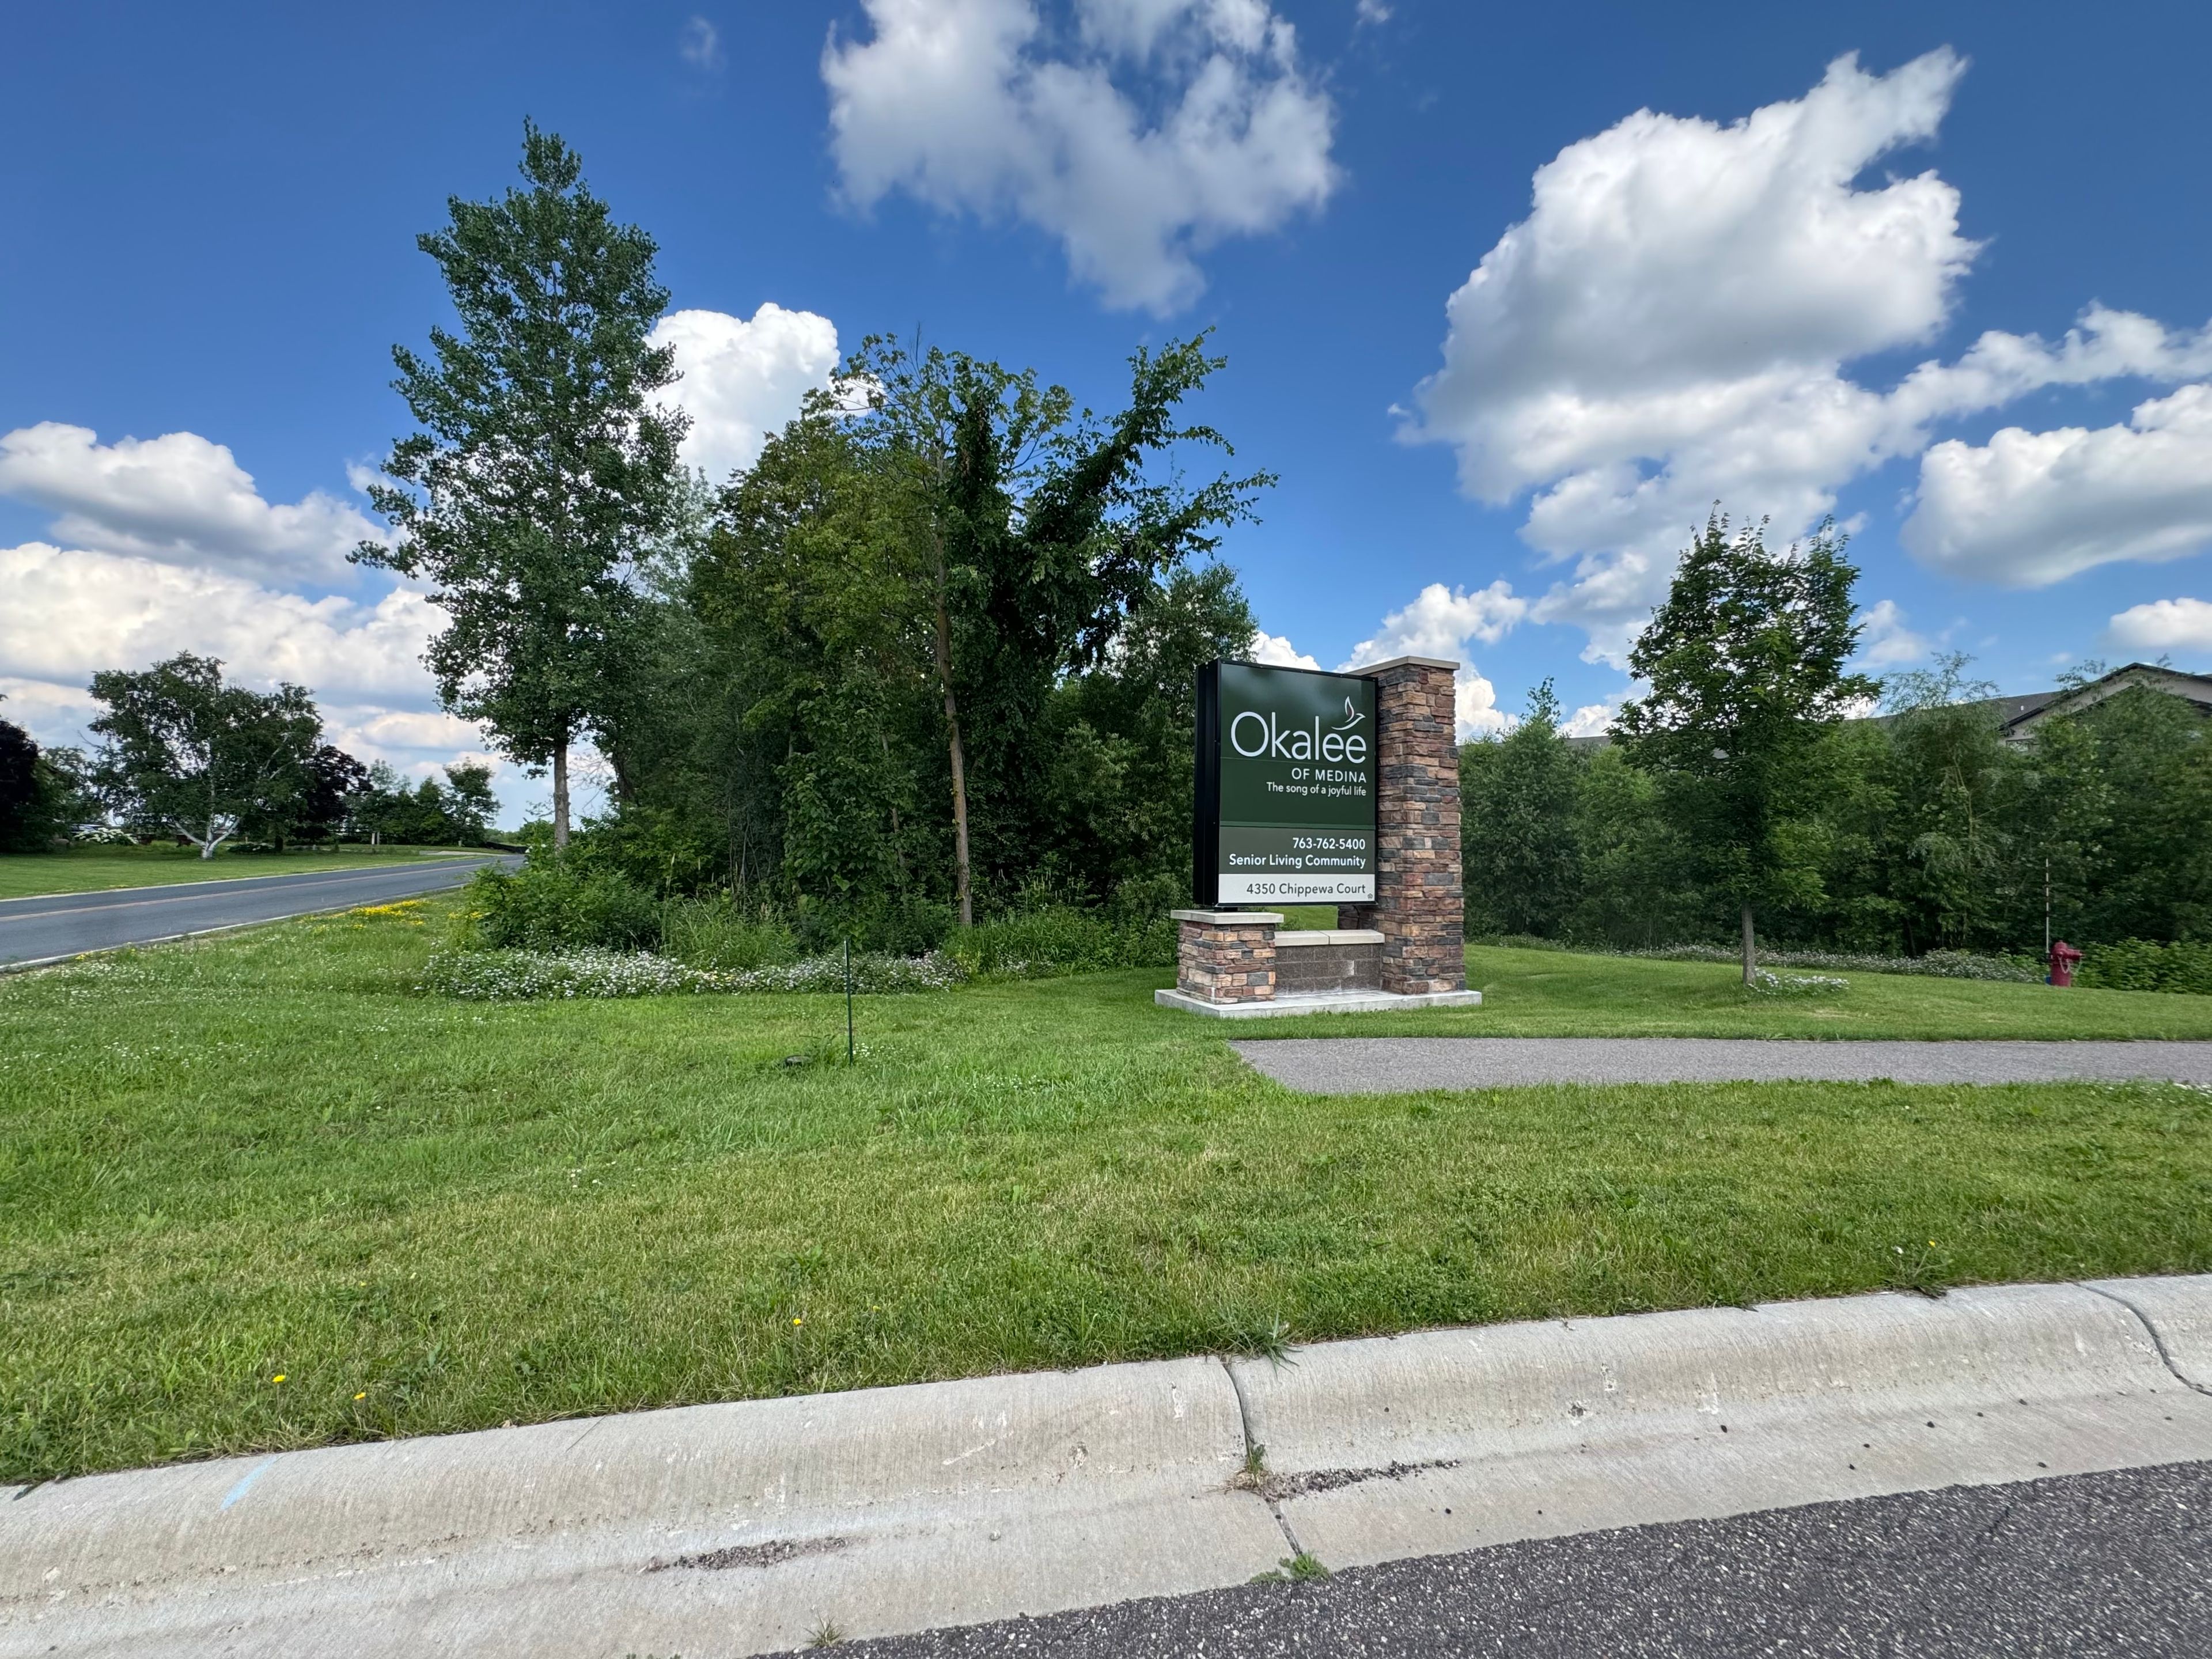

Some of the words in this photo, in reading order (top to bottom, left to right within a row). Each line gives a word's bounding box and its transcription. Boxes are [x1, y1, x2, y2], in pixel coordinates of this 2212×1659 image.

[1230, 711, 1367, 764] Okalee
[1291, 767, 1310, 780] OF
[1315, 769, 1367, 783] MEDINA
[1266, 782, 1284, 793] The
[1286, 785, 1308, 796] song
[1310, 783, 1320, 794] of
[1327, 785, 1352, 798] joyful
[1354, 786, 1367, 796] life
[1292, 837, 1366, 850] 763-762-5400
[1229, 853, 1267, 866] Senior
[1269, 854, 1302, 869] Living
[1305, 854, 1366, 869] Community
[1246, 883, 1275, 895] 4350
[1279, 882, 1334, 897] Chippewa
[1336, 882, 1366, 894] Court
